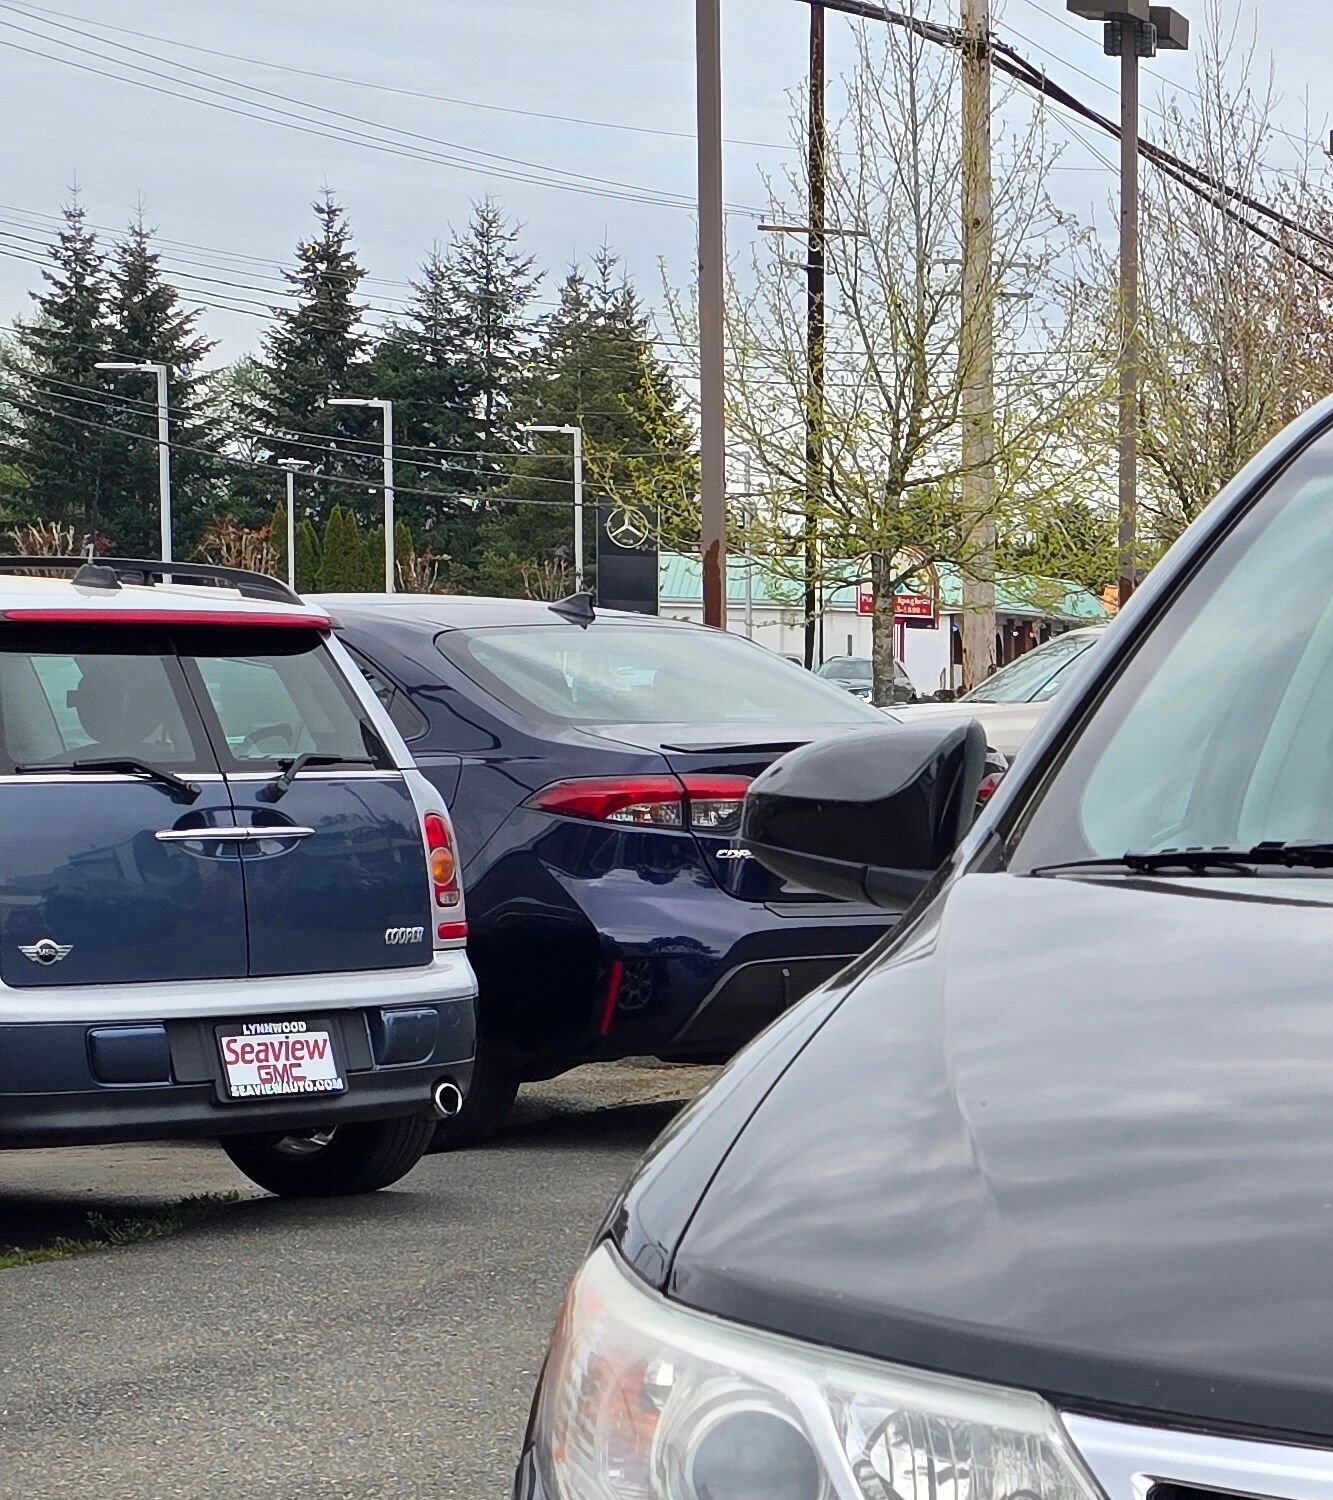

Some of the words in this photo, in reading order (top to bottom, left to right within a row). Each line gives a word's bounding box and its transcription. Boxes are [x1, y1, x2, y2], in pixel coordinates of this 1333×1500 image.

[242, 1021, 307, 1036] LYNNWOOD
[225, 1035, 328, 1066] Seaview
[256, 1062, 307, 1085] GMC
[230, 1077, 344, 1098] SEAVIEWAUTO.COM
